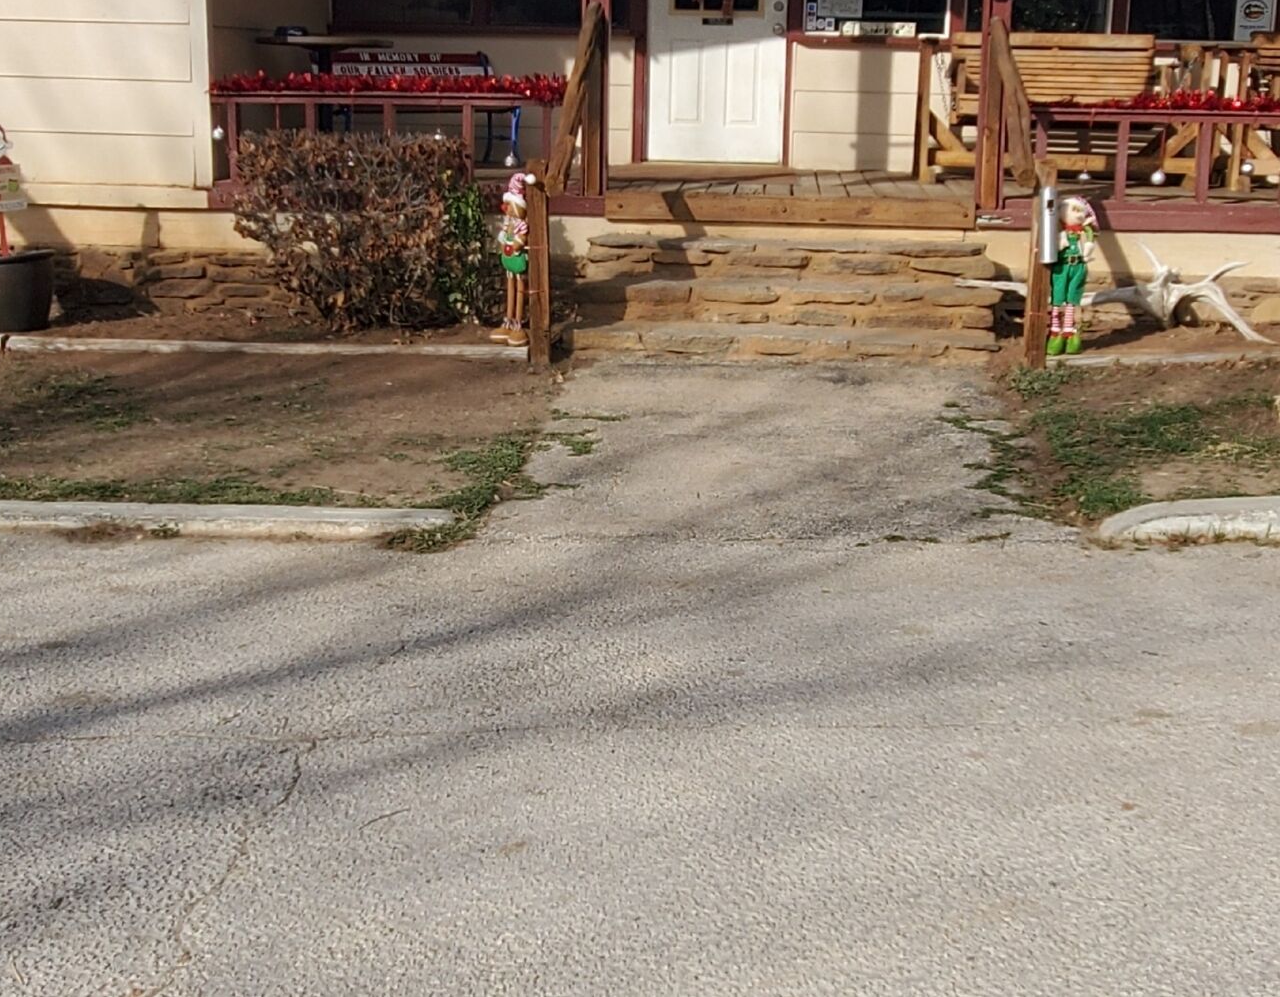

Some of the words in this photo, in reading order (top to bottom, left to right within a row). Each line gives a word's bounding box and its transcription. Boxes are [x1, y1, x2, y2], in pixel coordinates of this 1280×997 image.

[359, 53, 371, 62] IN
[377, 53, 420, 62] MEMORY
[429, 53, 441, 62] OF
[340, 66, 361, 74] OUR
[367, 66, 406, 75] FALLEN
[413, 66, 461, 75] SOLDIERS
